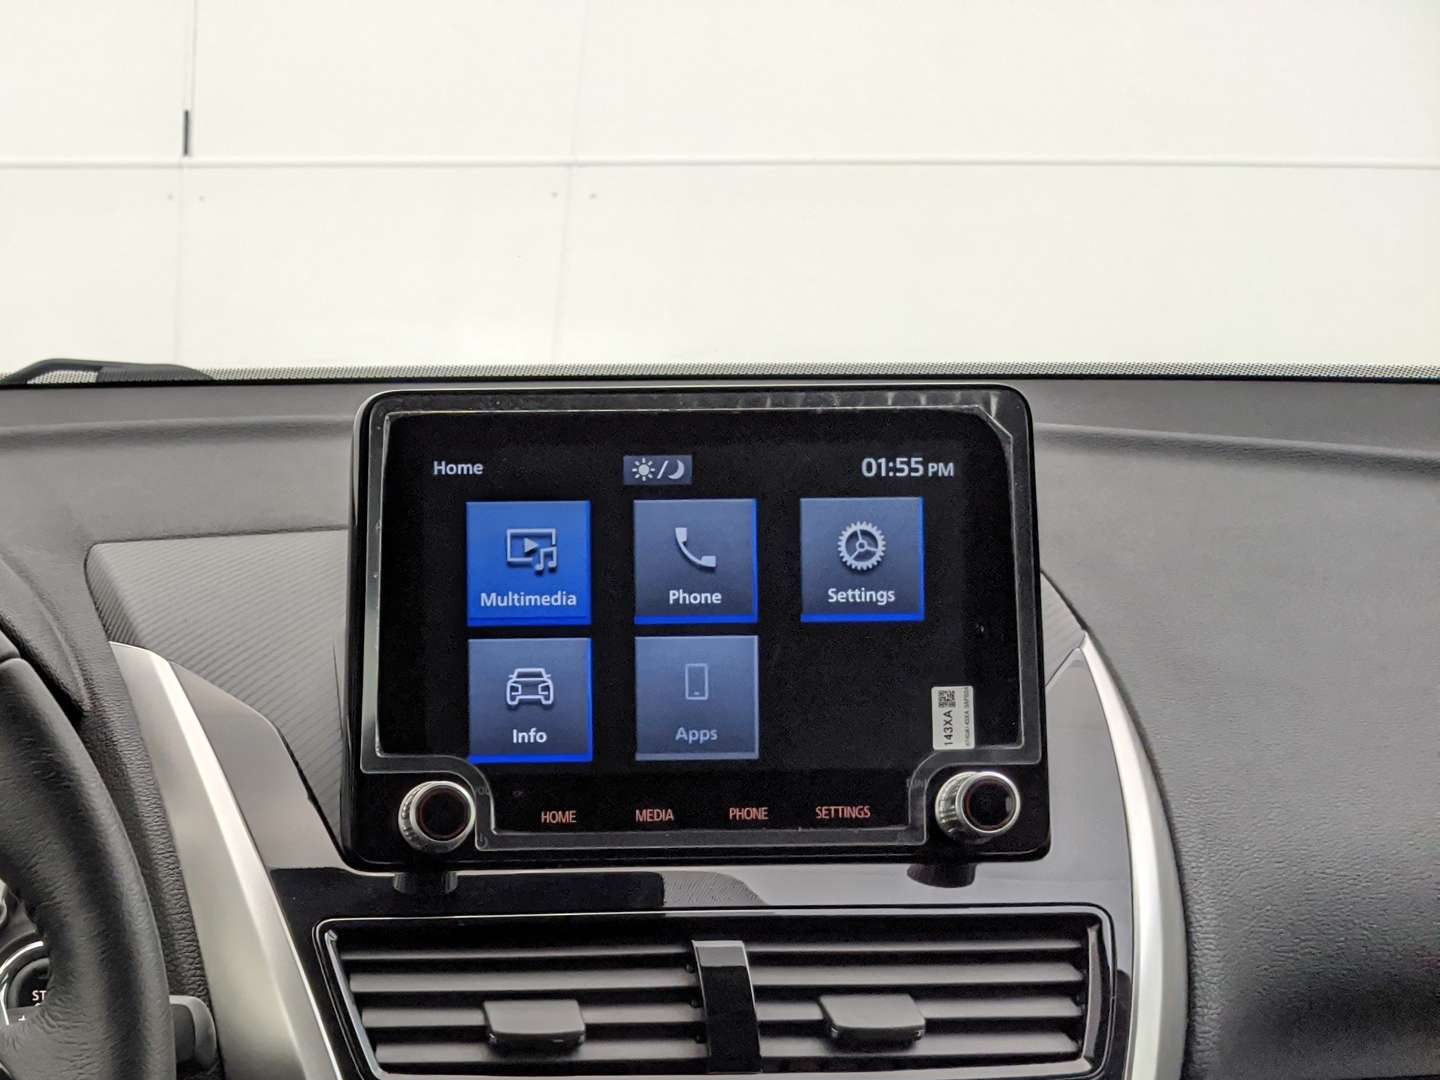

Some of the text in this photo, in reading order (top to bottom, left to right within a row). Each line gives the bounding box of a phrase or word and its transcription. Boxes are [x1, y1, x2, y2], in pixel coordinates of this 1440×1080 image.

[432, 460, 484, 476] Home
[861, 456, 955, 478] 01:55 PM
[479, 590, 577, 608] Multimedia
[668, 589, 722, 605] Phone
[827, 588, 896, 606] Settings
[512, 727, 548, 744] Info
[675, 726, 719, 745] Apps
[540, 810, 577, 824] HOME
[635, 808, 675, 822] MEDIA
[728, 806, 769, 821] PHONE
[815, 805, 871, 820] SETTINGS
